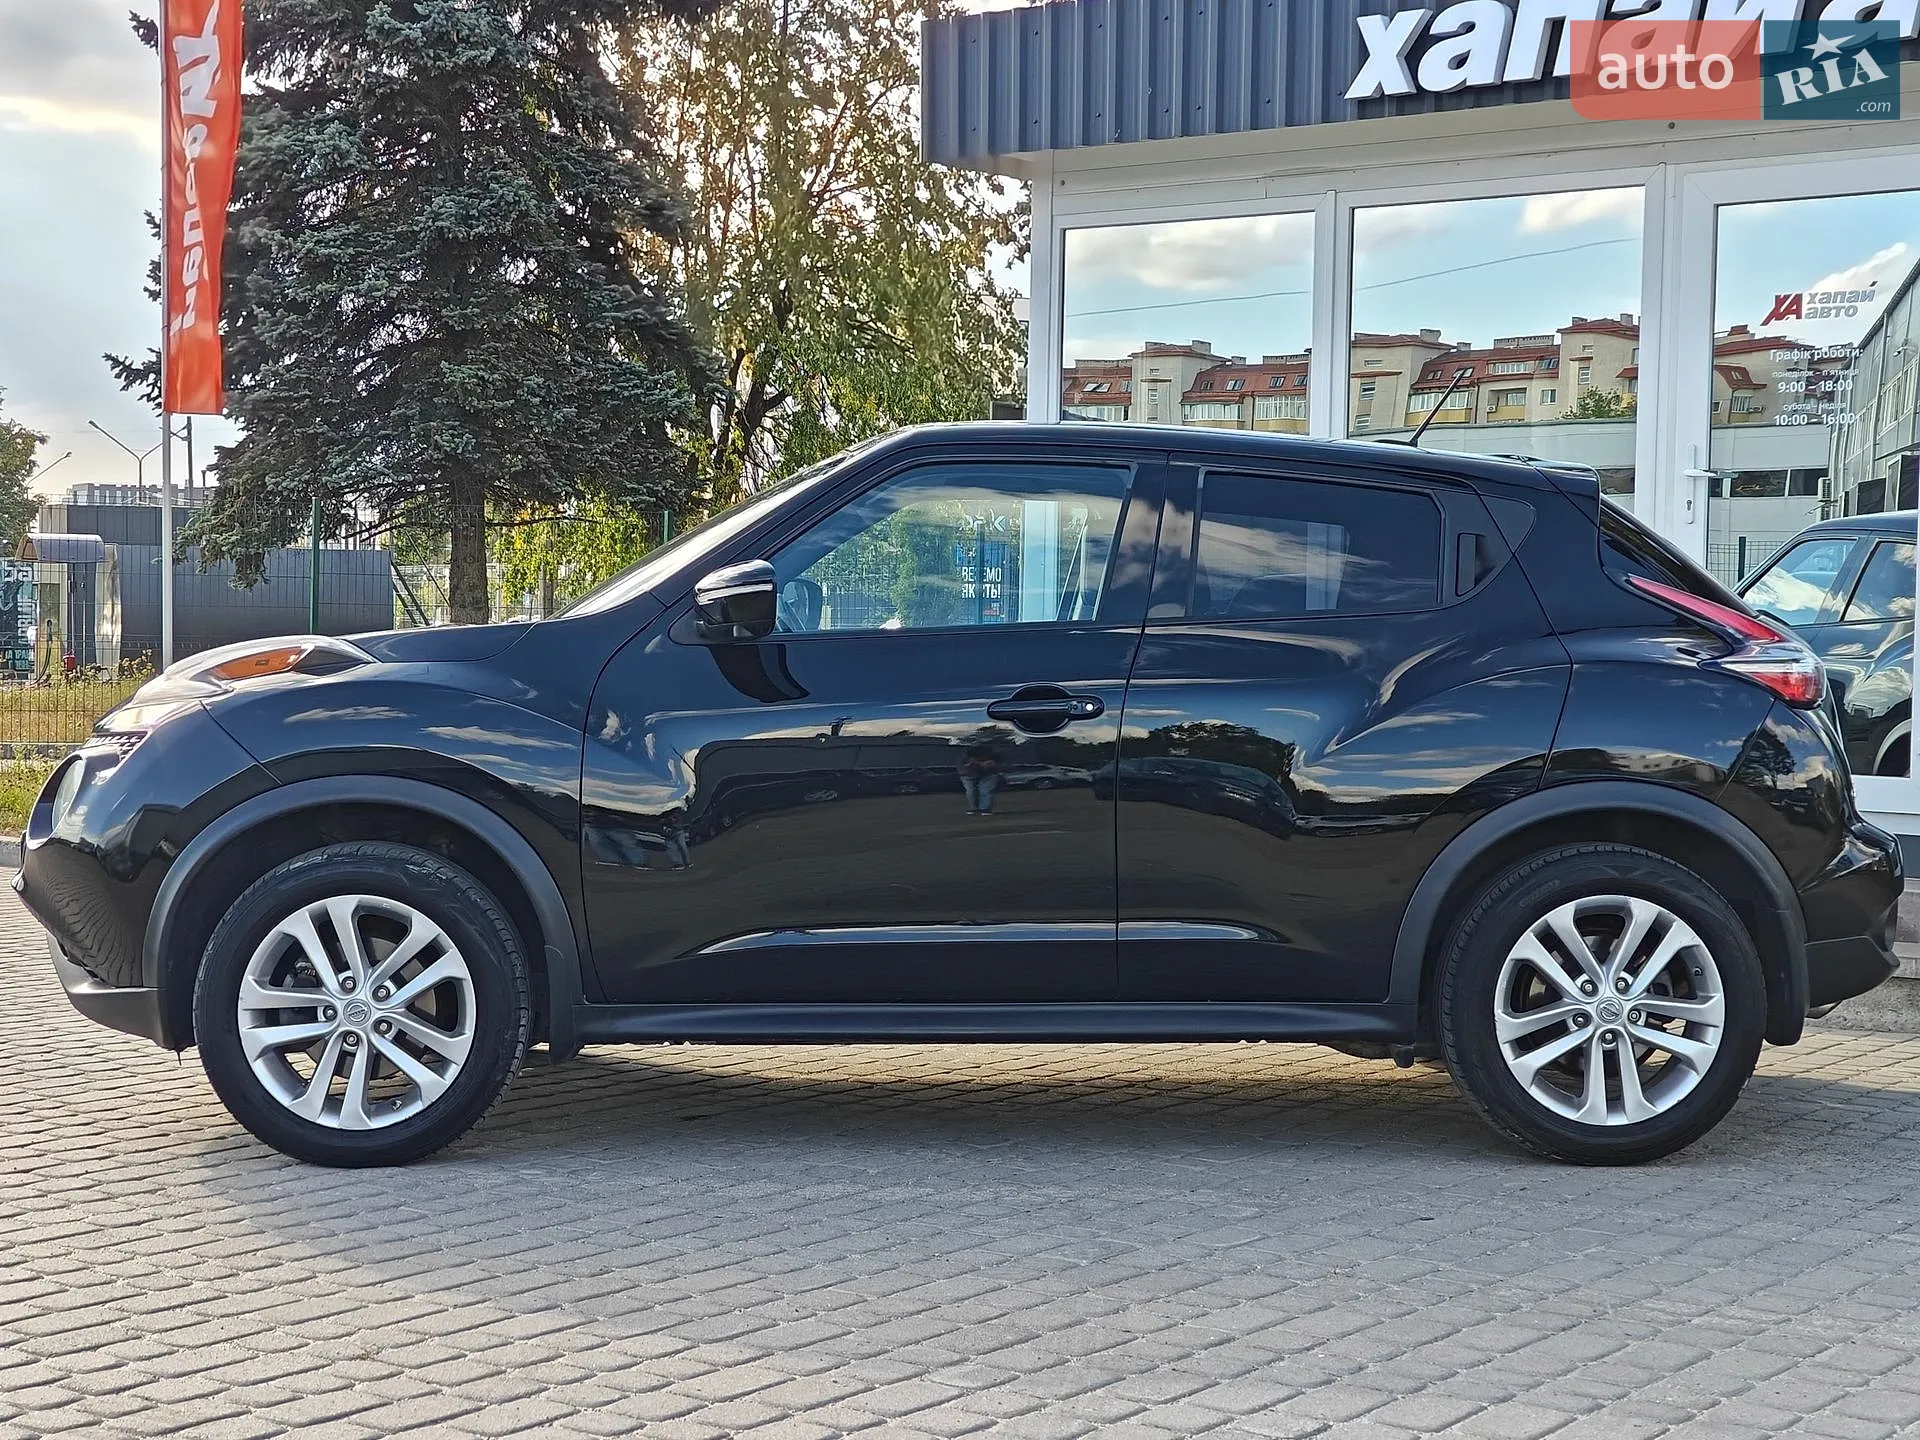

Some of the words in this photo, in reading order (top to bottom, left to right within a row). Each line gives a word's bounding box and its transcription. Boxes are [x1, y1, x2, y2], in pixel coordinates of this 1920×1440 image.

[1807, 281, 1878, 305] хапай
[1804, 305, 1858, 319] авто
[1770, 348, 1812, 362] Графік
[1814, 347, 1864, 361] роботи:
[1778, 382, 1806, 393] 9:00
[1820, 380, 1853, 392] 18:00
[1774, 415, 1807, 426] 10:00
[1822, 413, 1856, 425] 16:00
[962, 566, 1001, 581] ВЕЕМО
[962, 584, 1001, 599] ЯКТЬ!
